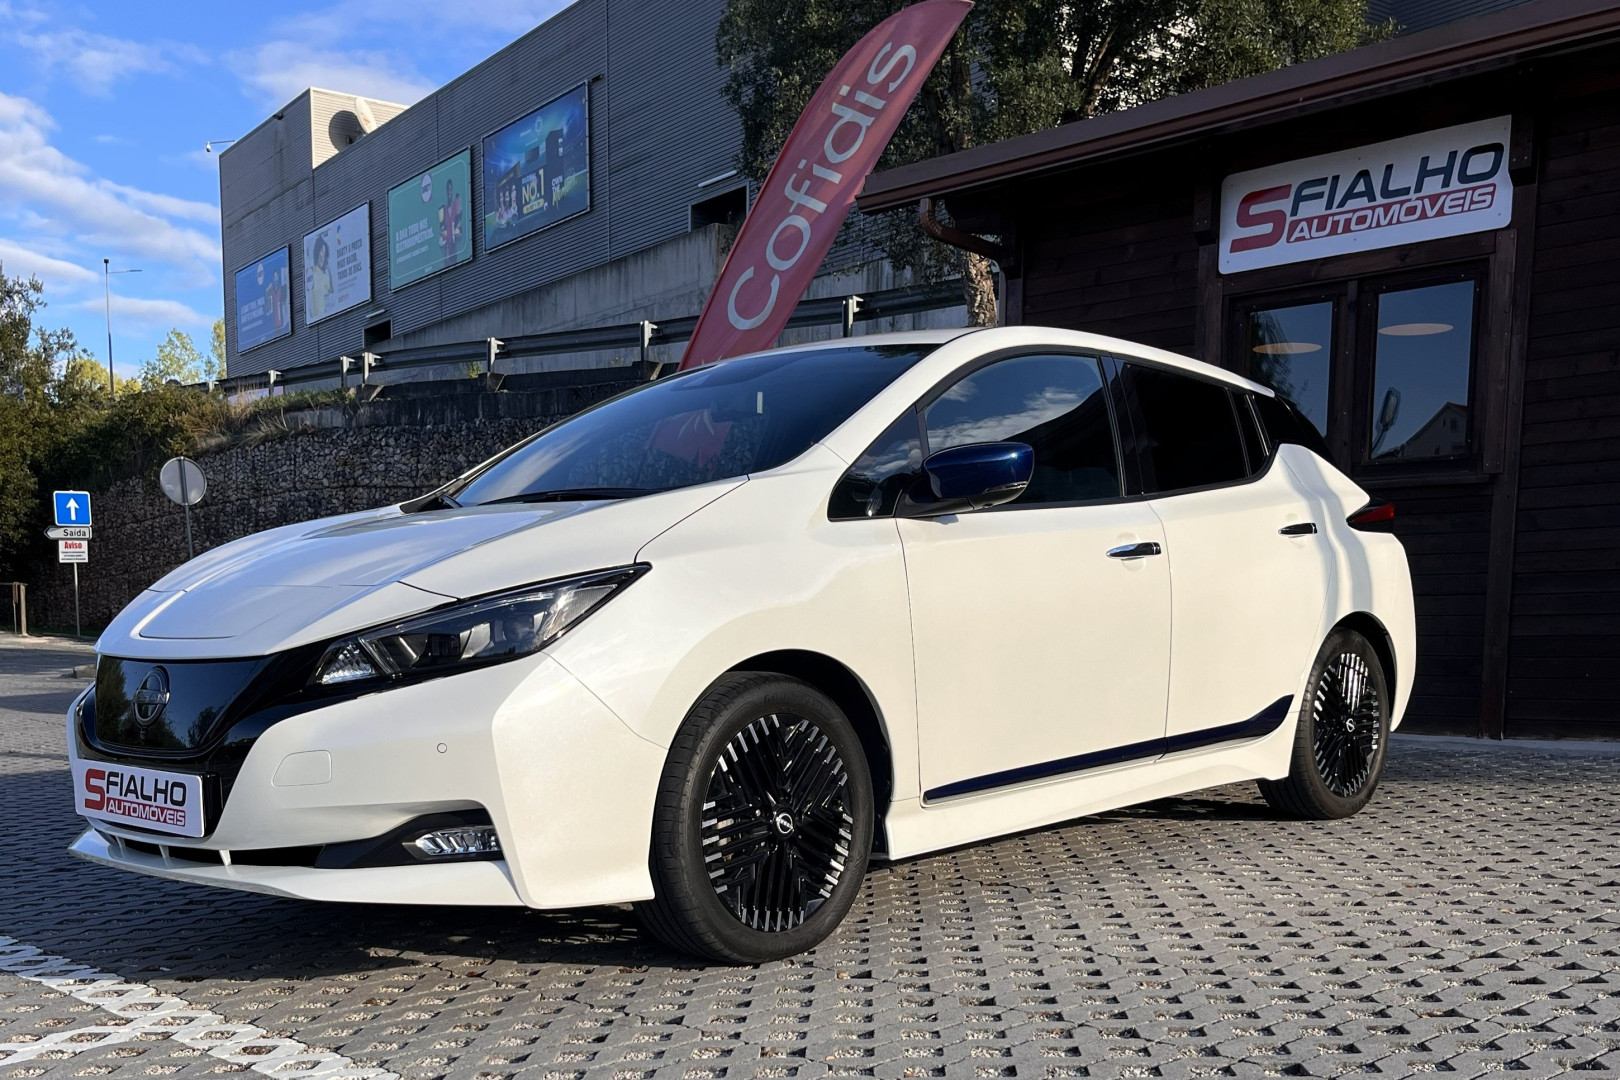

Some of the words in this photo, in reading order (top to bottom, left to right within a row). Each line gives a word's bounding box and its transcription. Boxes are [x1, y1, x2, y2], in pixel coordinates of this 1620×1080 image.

[727, 42, 917, 330] Cofidis
[1289, 186, 1493, 242] AUTOMÓVEIS
[64, 541, 83, 549] Aviso
[107, 799, 186, 826] AUTOMÓVEIS
